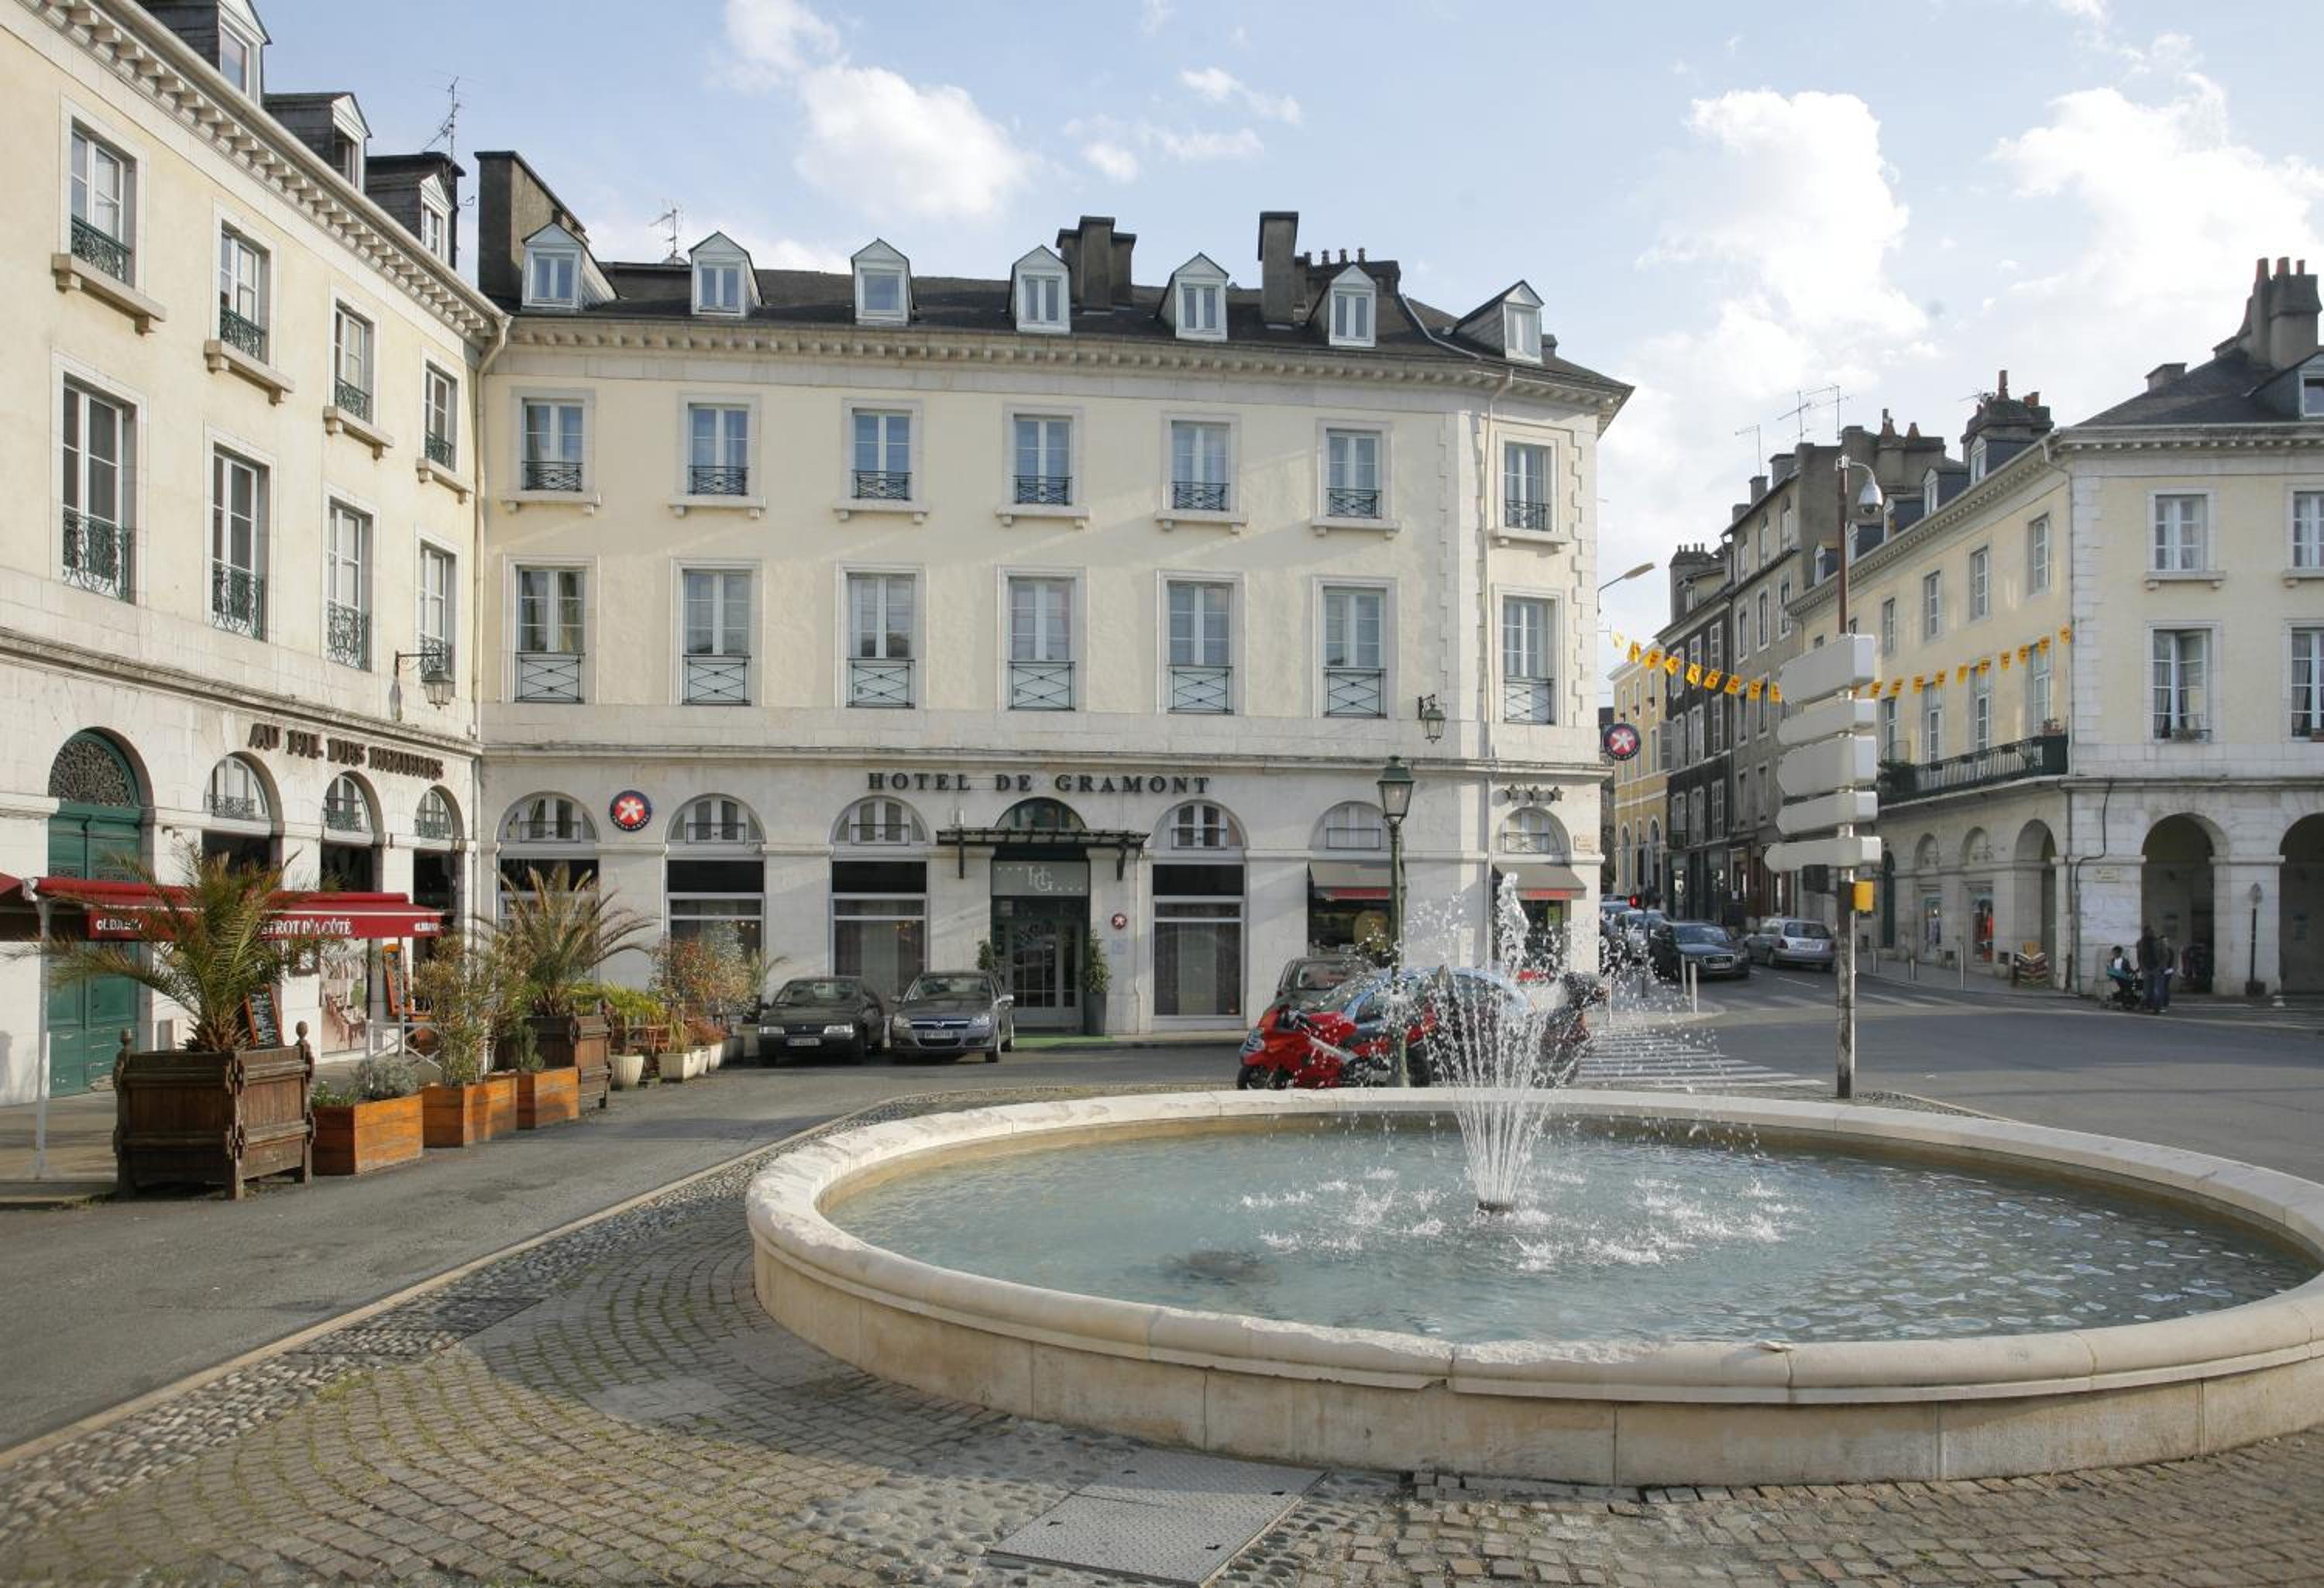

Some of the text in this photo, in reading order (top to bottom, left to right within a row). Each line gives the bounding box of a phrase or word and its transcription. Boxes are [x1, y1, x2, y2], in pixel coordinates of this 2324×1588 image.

[247, 722, 281, 751] AU
[326, 737, 366, 767] DES
[868, 772, 1210, 794] HOTEL DE GRAMONT
